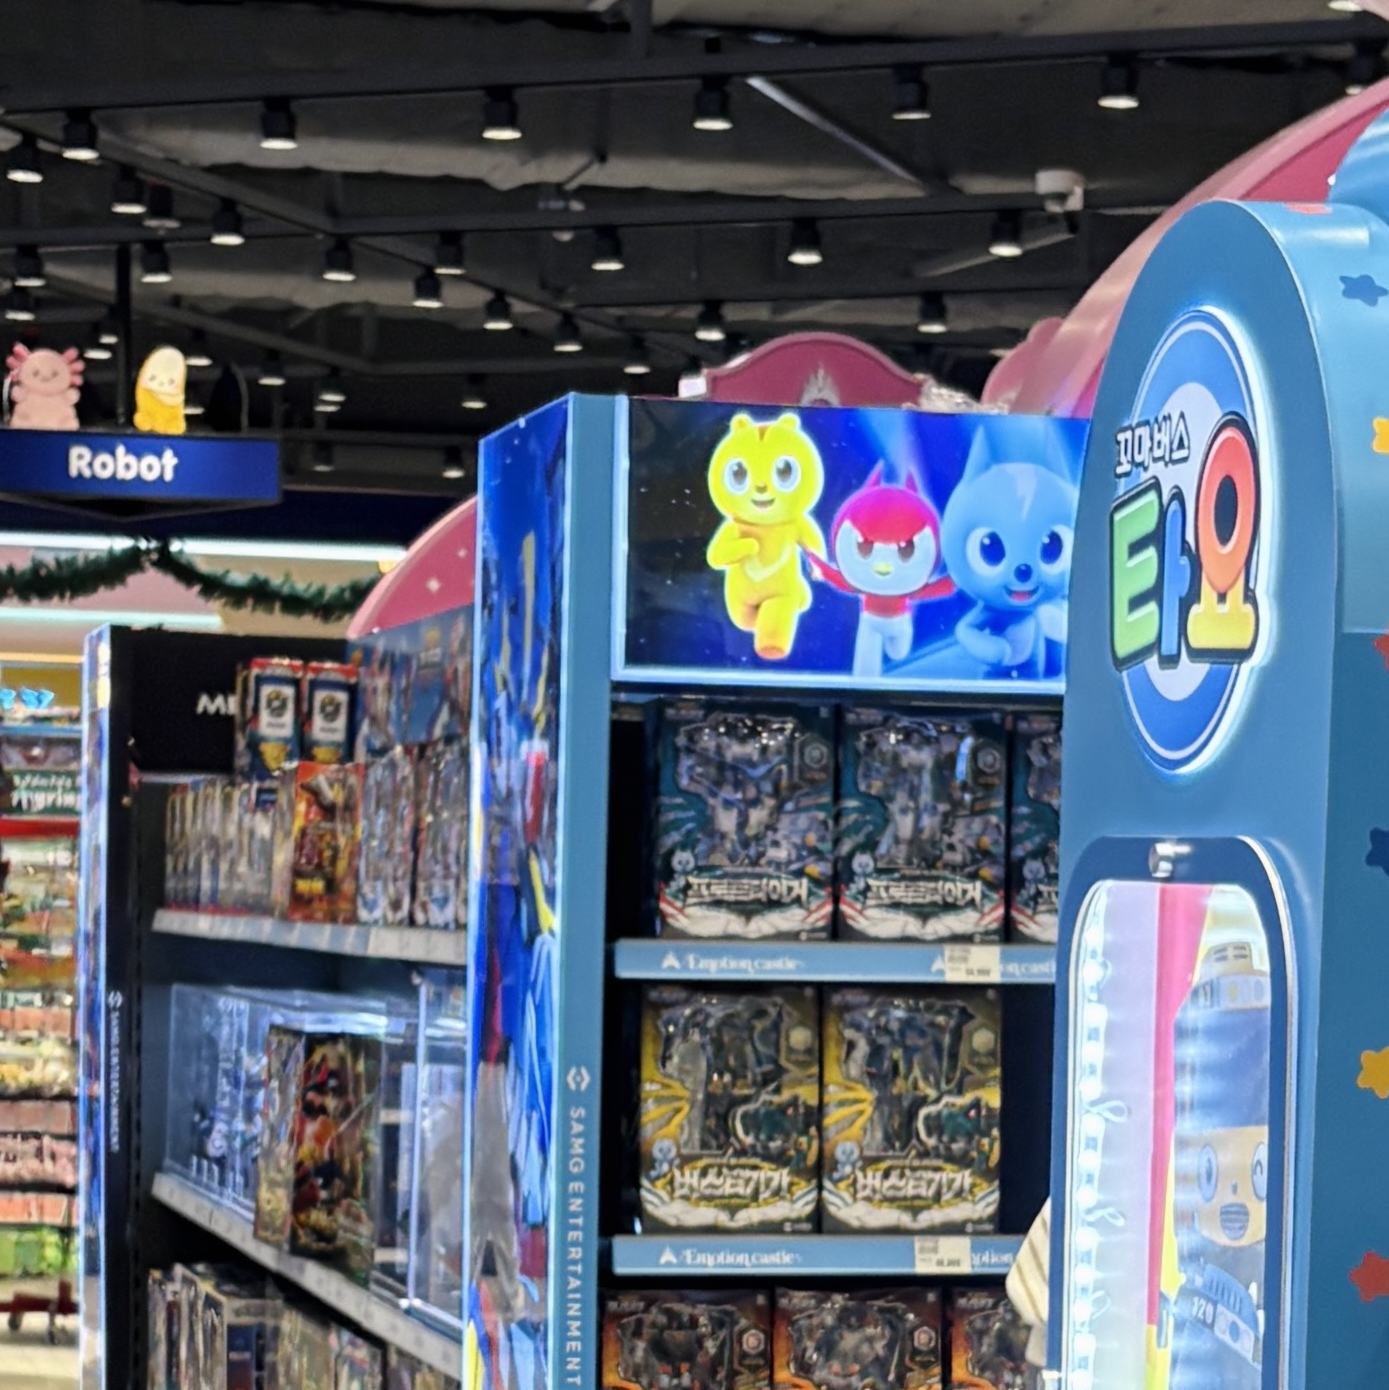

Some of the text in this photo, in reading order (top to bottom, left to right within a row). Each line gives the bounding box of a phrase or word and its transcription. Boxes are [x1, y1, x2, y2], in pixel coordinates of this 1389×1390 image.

[68, 445, 178, 483] Robot
[1113, 410, 1192, 478] 꼬마버스
[1109, 413, 1262, 673] 타요
[565, 1106, 587, 1388] SAMG ENTERTAINMENT
